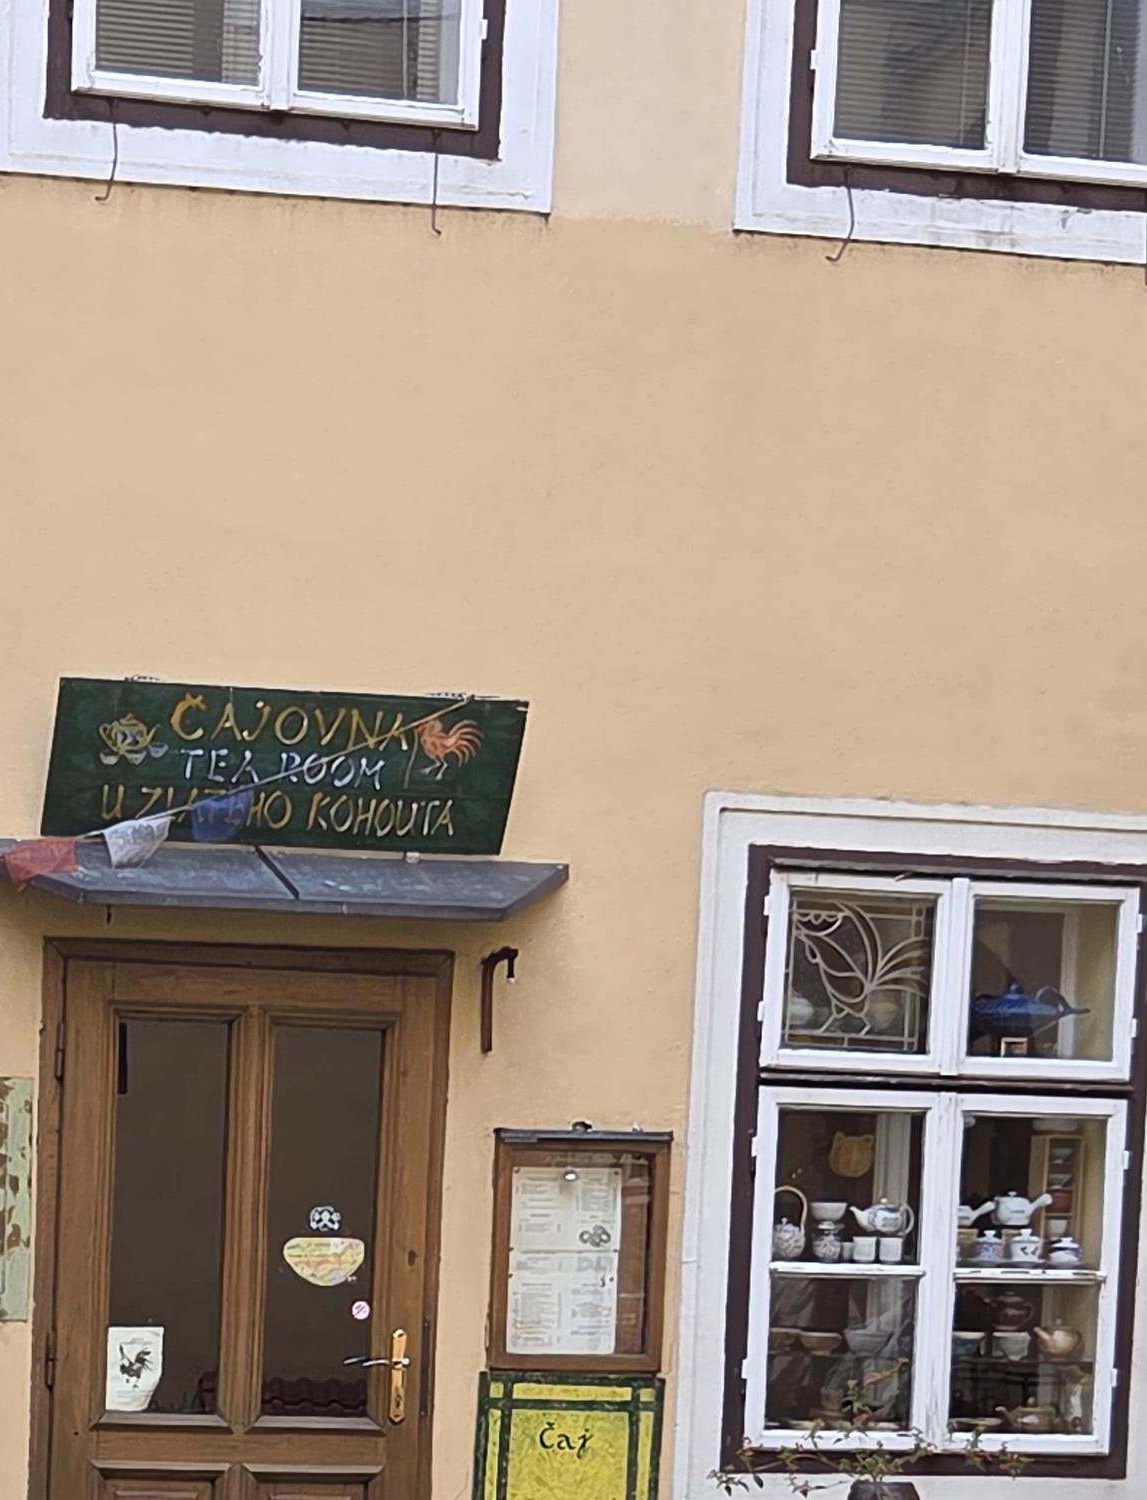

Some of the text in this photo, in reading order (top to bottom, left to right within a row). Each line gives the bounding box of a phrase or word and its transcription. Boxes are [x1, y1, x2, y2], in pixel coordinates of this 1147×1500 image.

[170, 692, 408, 751] ČAJOVNA
[181, 748, 386, 791] TEA ROOM
[101, 784, 125, 820] U
[307, 791, 454, 837] KOHOUTA
[539, 1421, 594, 1460] Čaj
